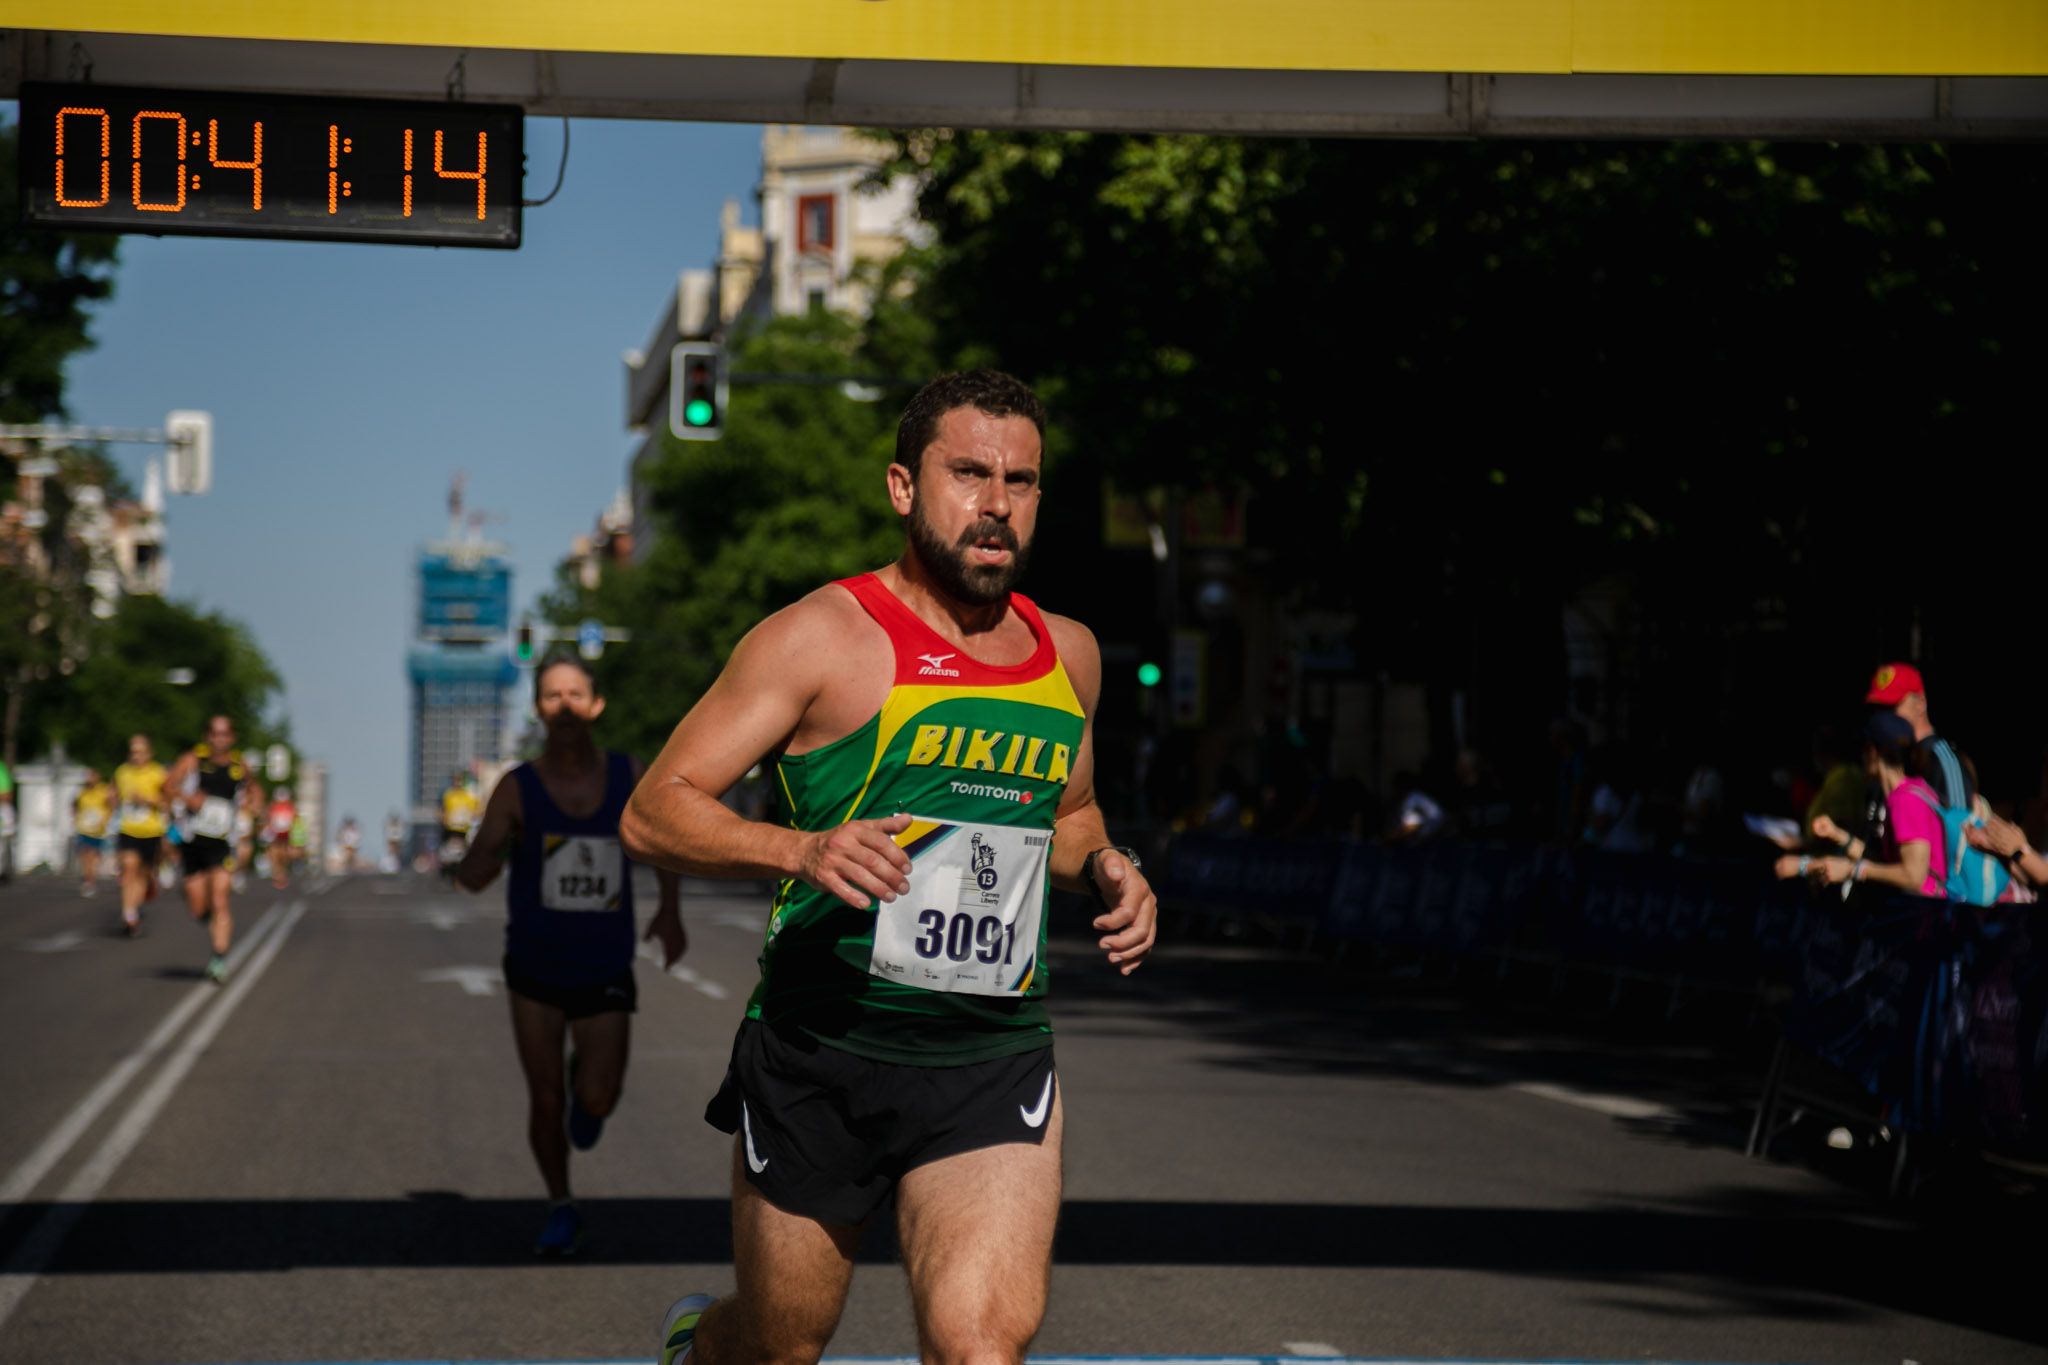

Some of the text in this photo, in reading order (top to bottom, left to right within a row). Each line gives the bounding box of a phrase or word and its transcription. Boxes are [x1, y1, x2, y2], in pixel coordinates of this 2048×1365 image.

[55, 106, 488, 222] 00:41:14
[906, 724, 1070, 785] BIKILA
[981, 873, 995, 886] 13
[915, 908, 1016, 965] 3091
